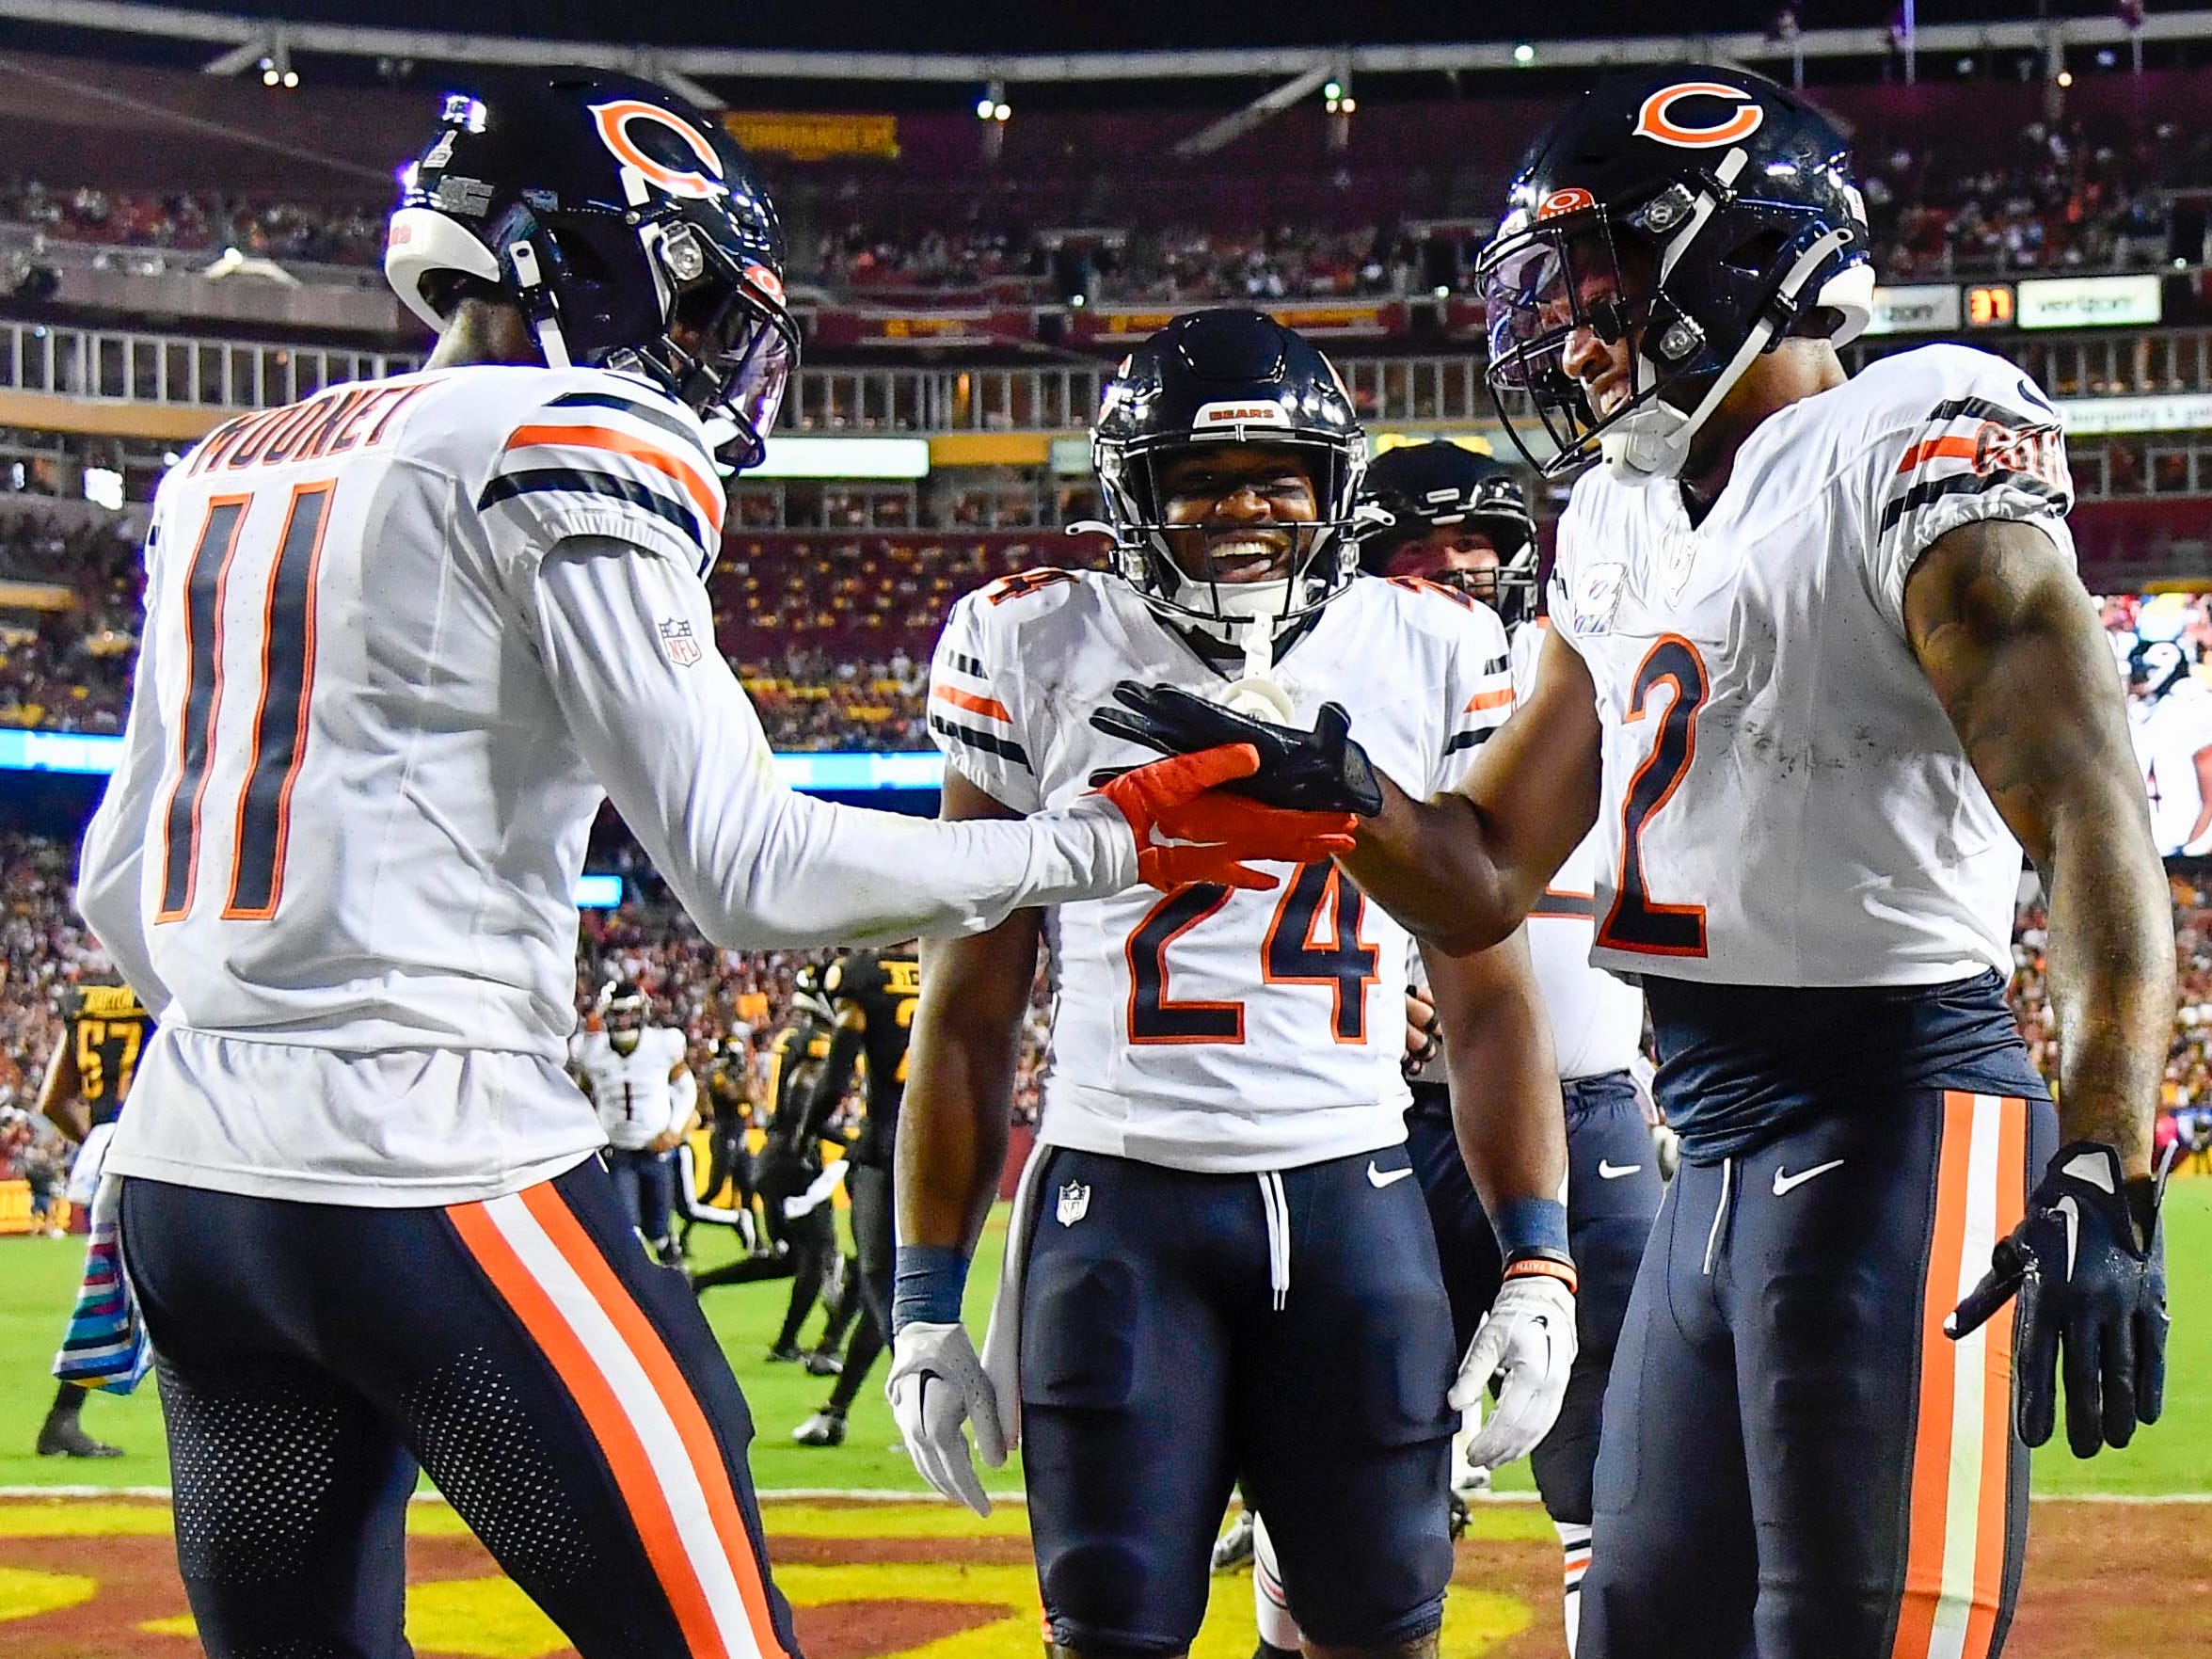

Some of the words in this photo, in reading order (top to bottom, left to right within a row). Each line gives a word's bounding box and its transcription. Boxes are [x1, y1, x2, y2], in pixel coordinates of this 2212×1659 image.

[1209, 408, 1274, 422] BEARS
[154, 477, 339, 925] 11
[1596, 633, 1710, 958] 2
[1124, 852, 1380, 1045] 24
[77, 1019, 142, 1100] 57
[623, 1080, 634, 1122] 1
